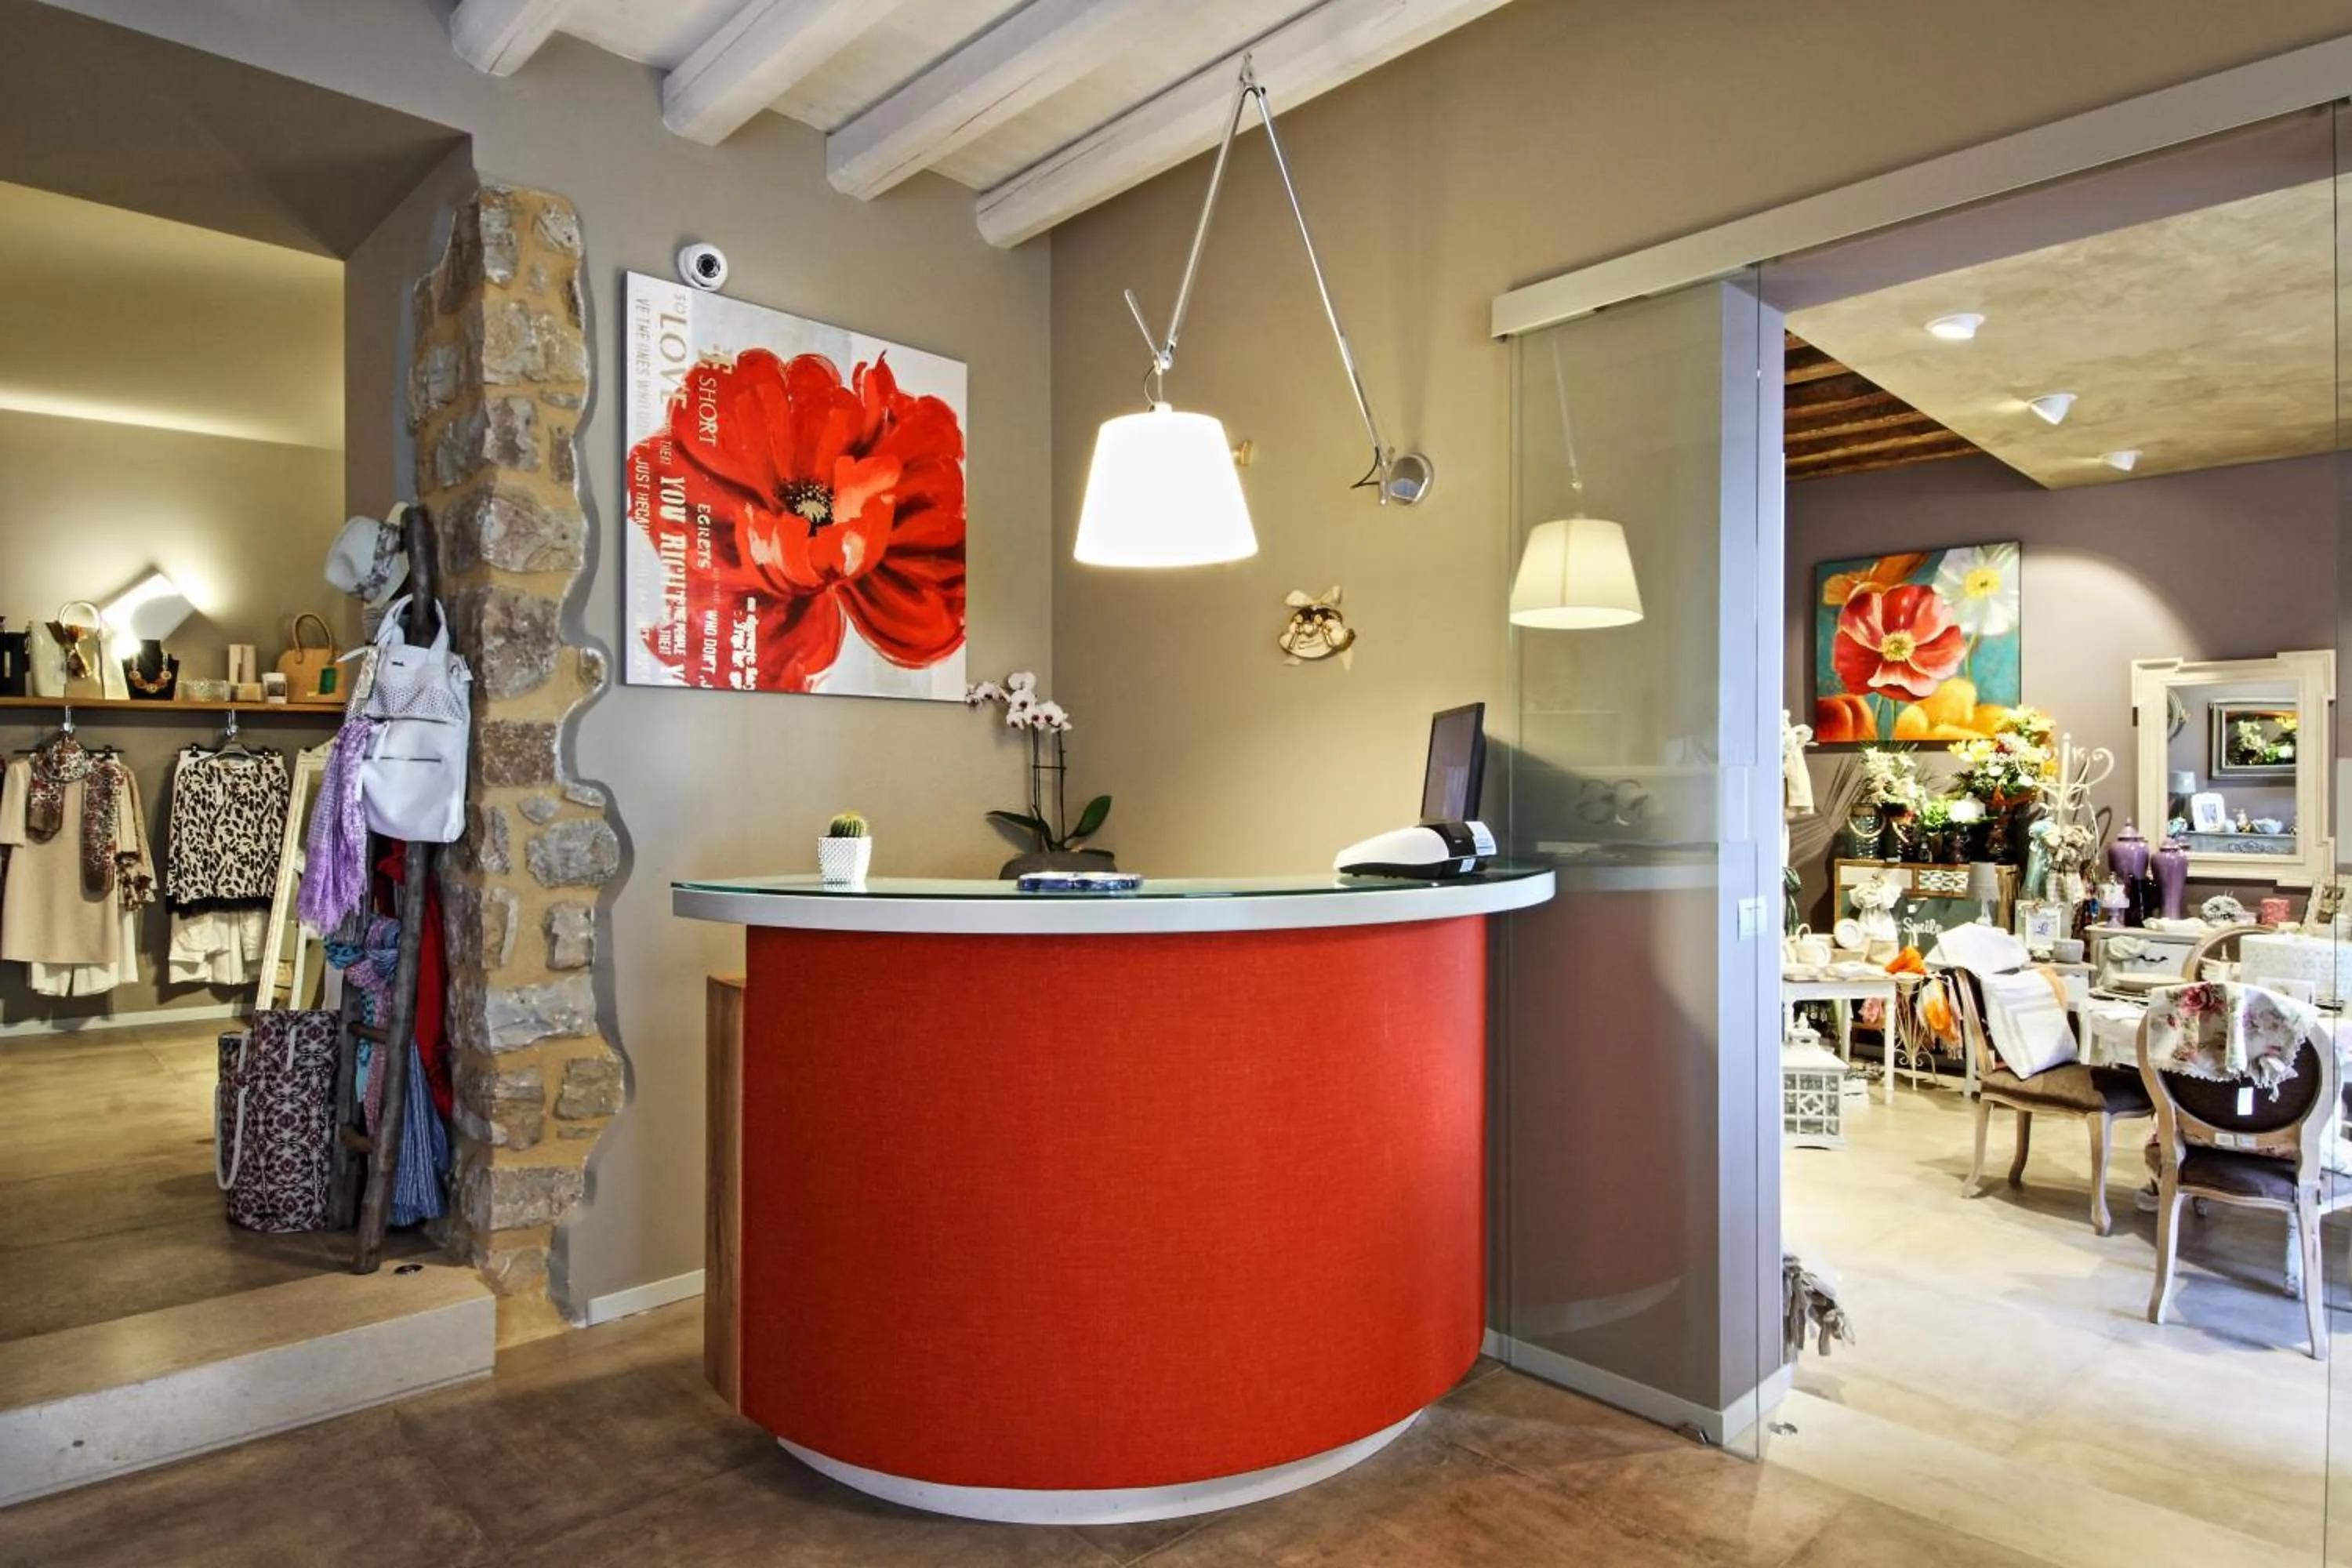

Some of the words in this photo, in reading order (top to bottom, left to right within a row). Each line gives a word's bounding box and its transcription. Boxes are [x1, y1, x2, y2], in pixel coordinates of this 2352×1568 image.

[659, 314, 688, 409] LOVE
[699, 376, 718, 447] SHORT
[659, 476, 688, 524] YOU
[705, 610, 717, 635] WHO
